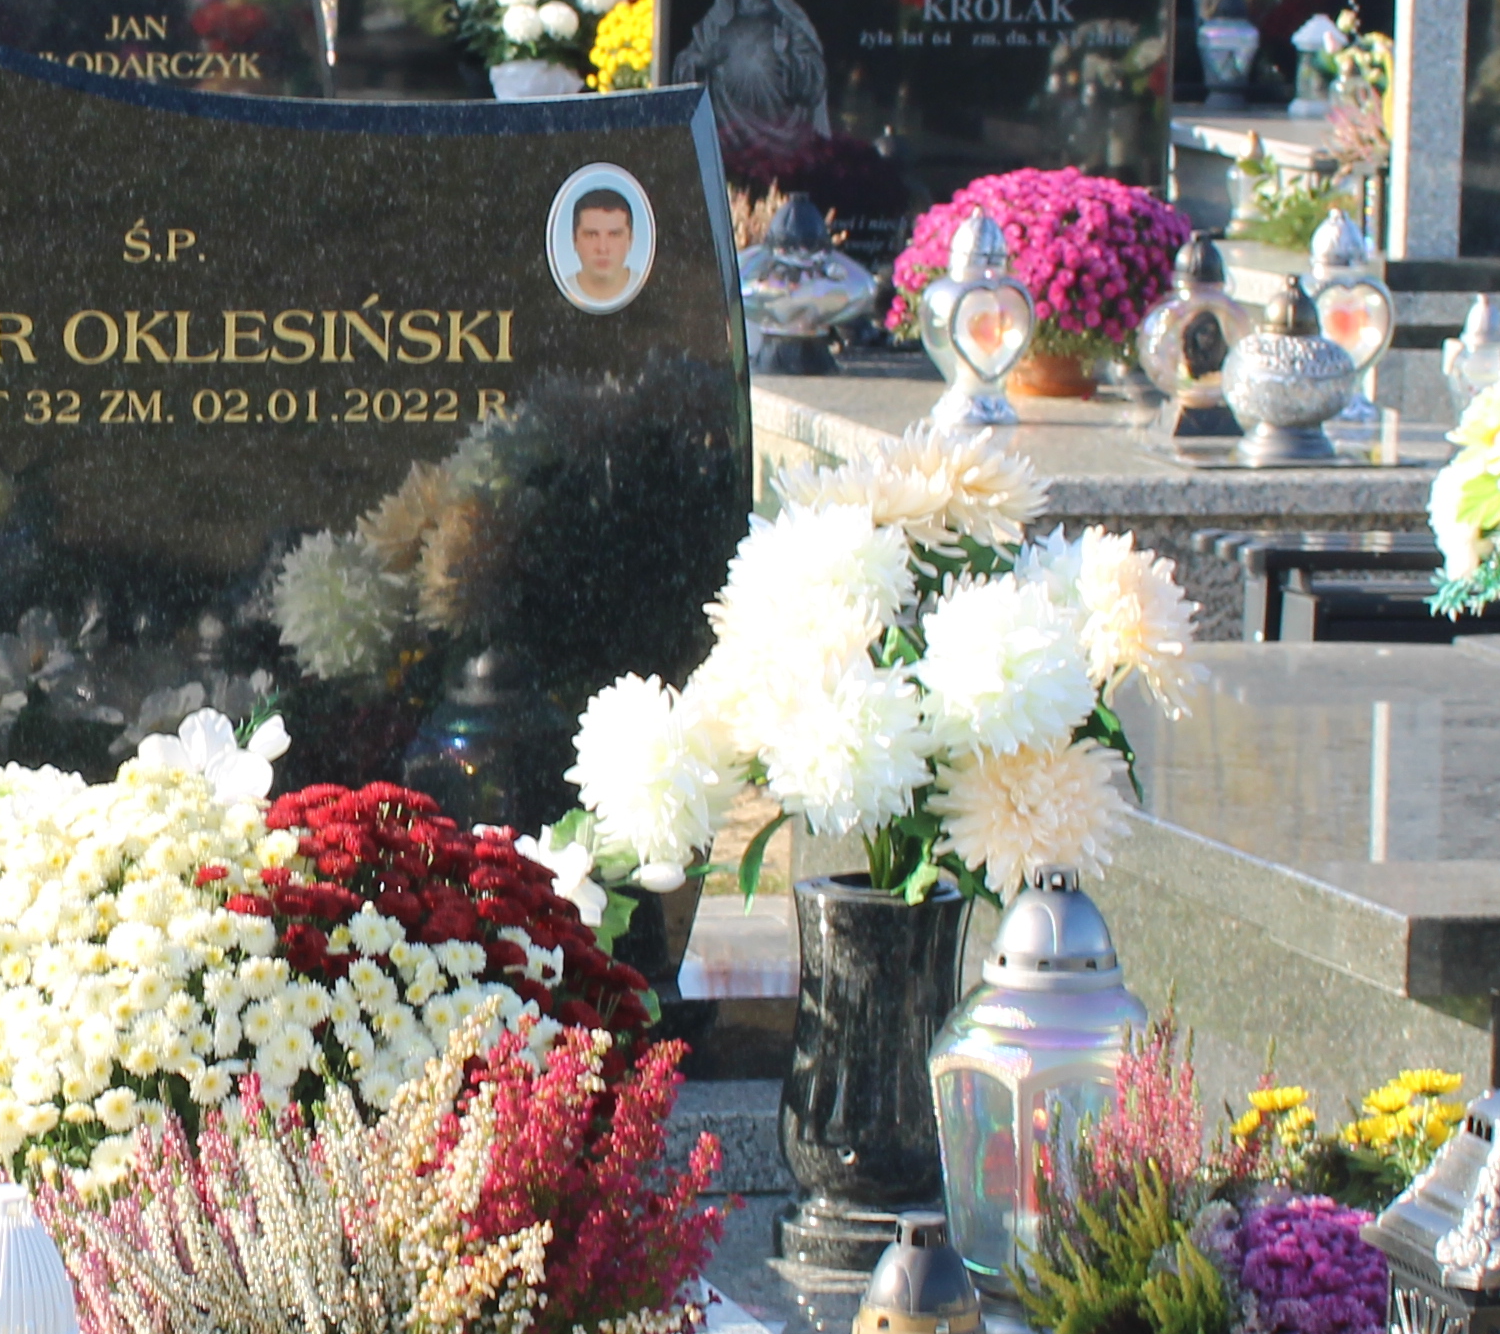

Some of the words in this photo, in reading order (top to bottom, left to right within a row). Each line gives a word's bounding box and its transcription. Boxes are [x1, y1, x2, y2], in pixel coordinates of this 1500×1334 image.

[105, 15, 167, 41] JAN
[122, 218, 206, 264] Ś.P.
[62, 293, 515, 366] OKLESIŃSKI
[24, 389, 81, 423] 32
[100, 389, 175, 424] ZM.
[192, 387, 459, 424] 02.01.2022
